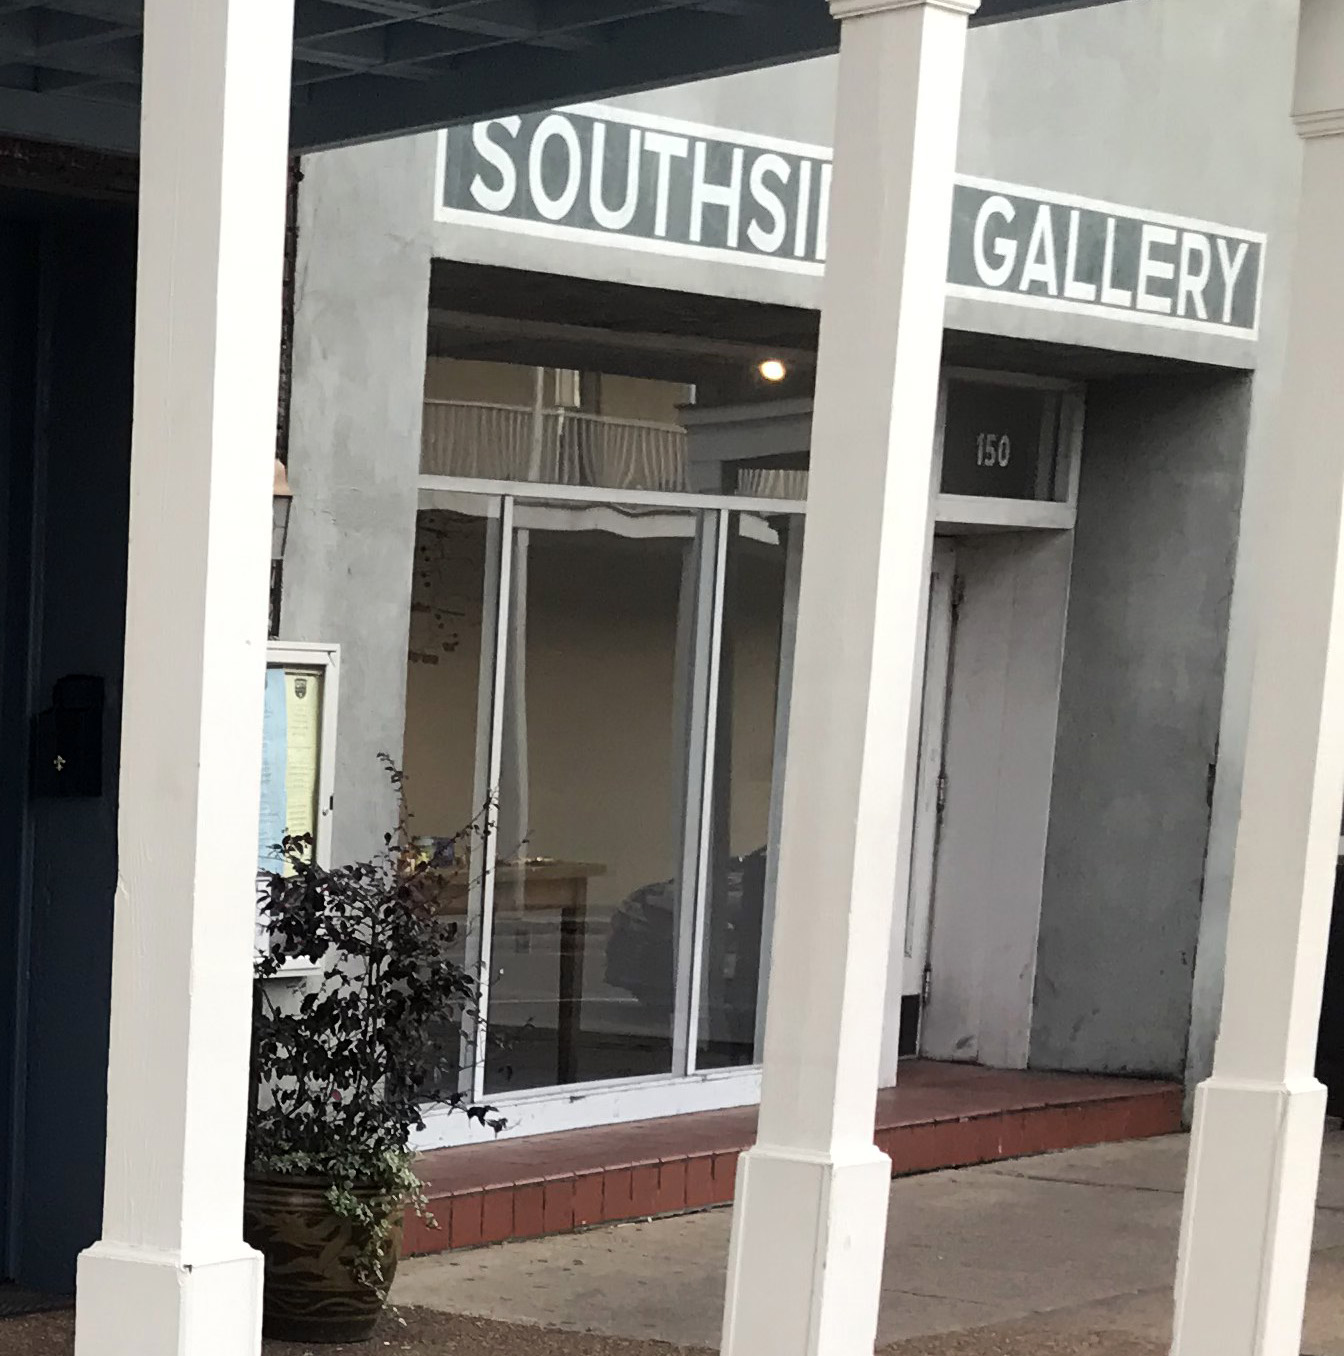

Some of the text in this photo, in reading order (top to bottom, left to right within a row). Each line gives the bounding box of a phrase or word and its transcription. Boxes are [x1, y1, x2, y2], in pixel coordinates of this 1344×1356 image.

[469, 114, 1249, 323] SOUTHSI GALLERY
[976, 432, 1011, 467] 150
